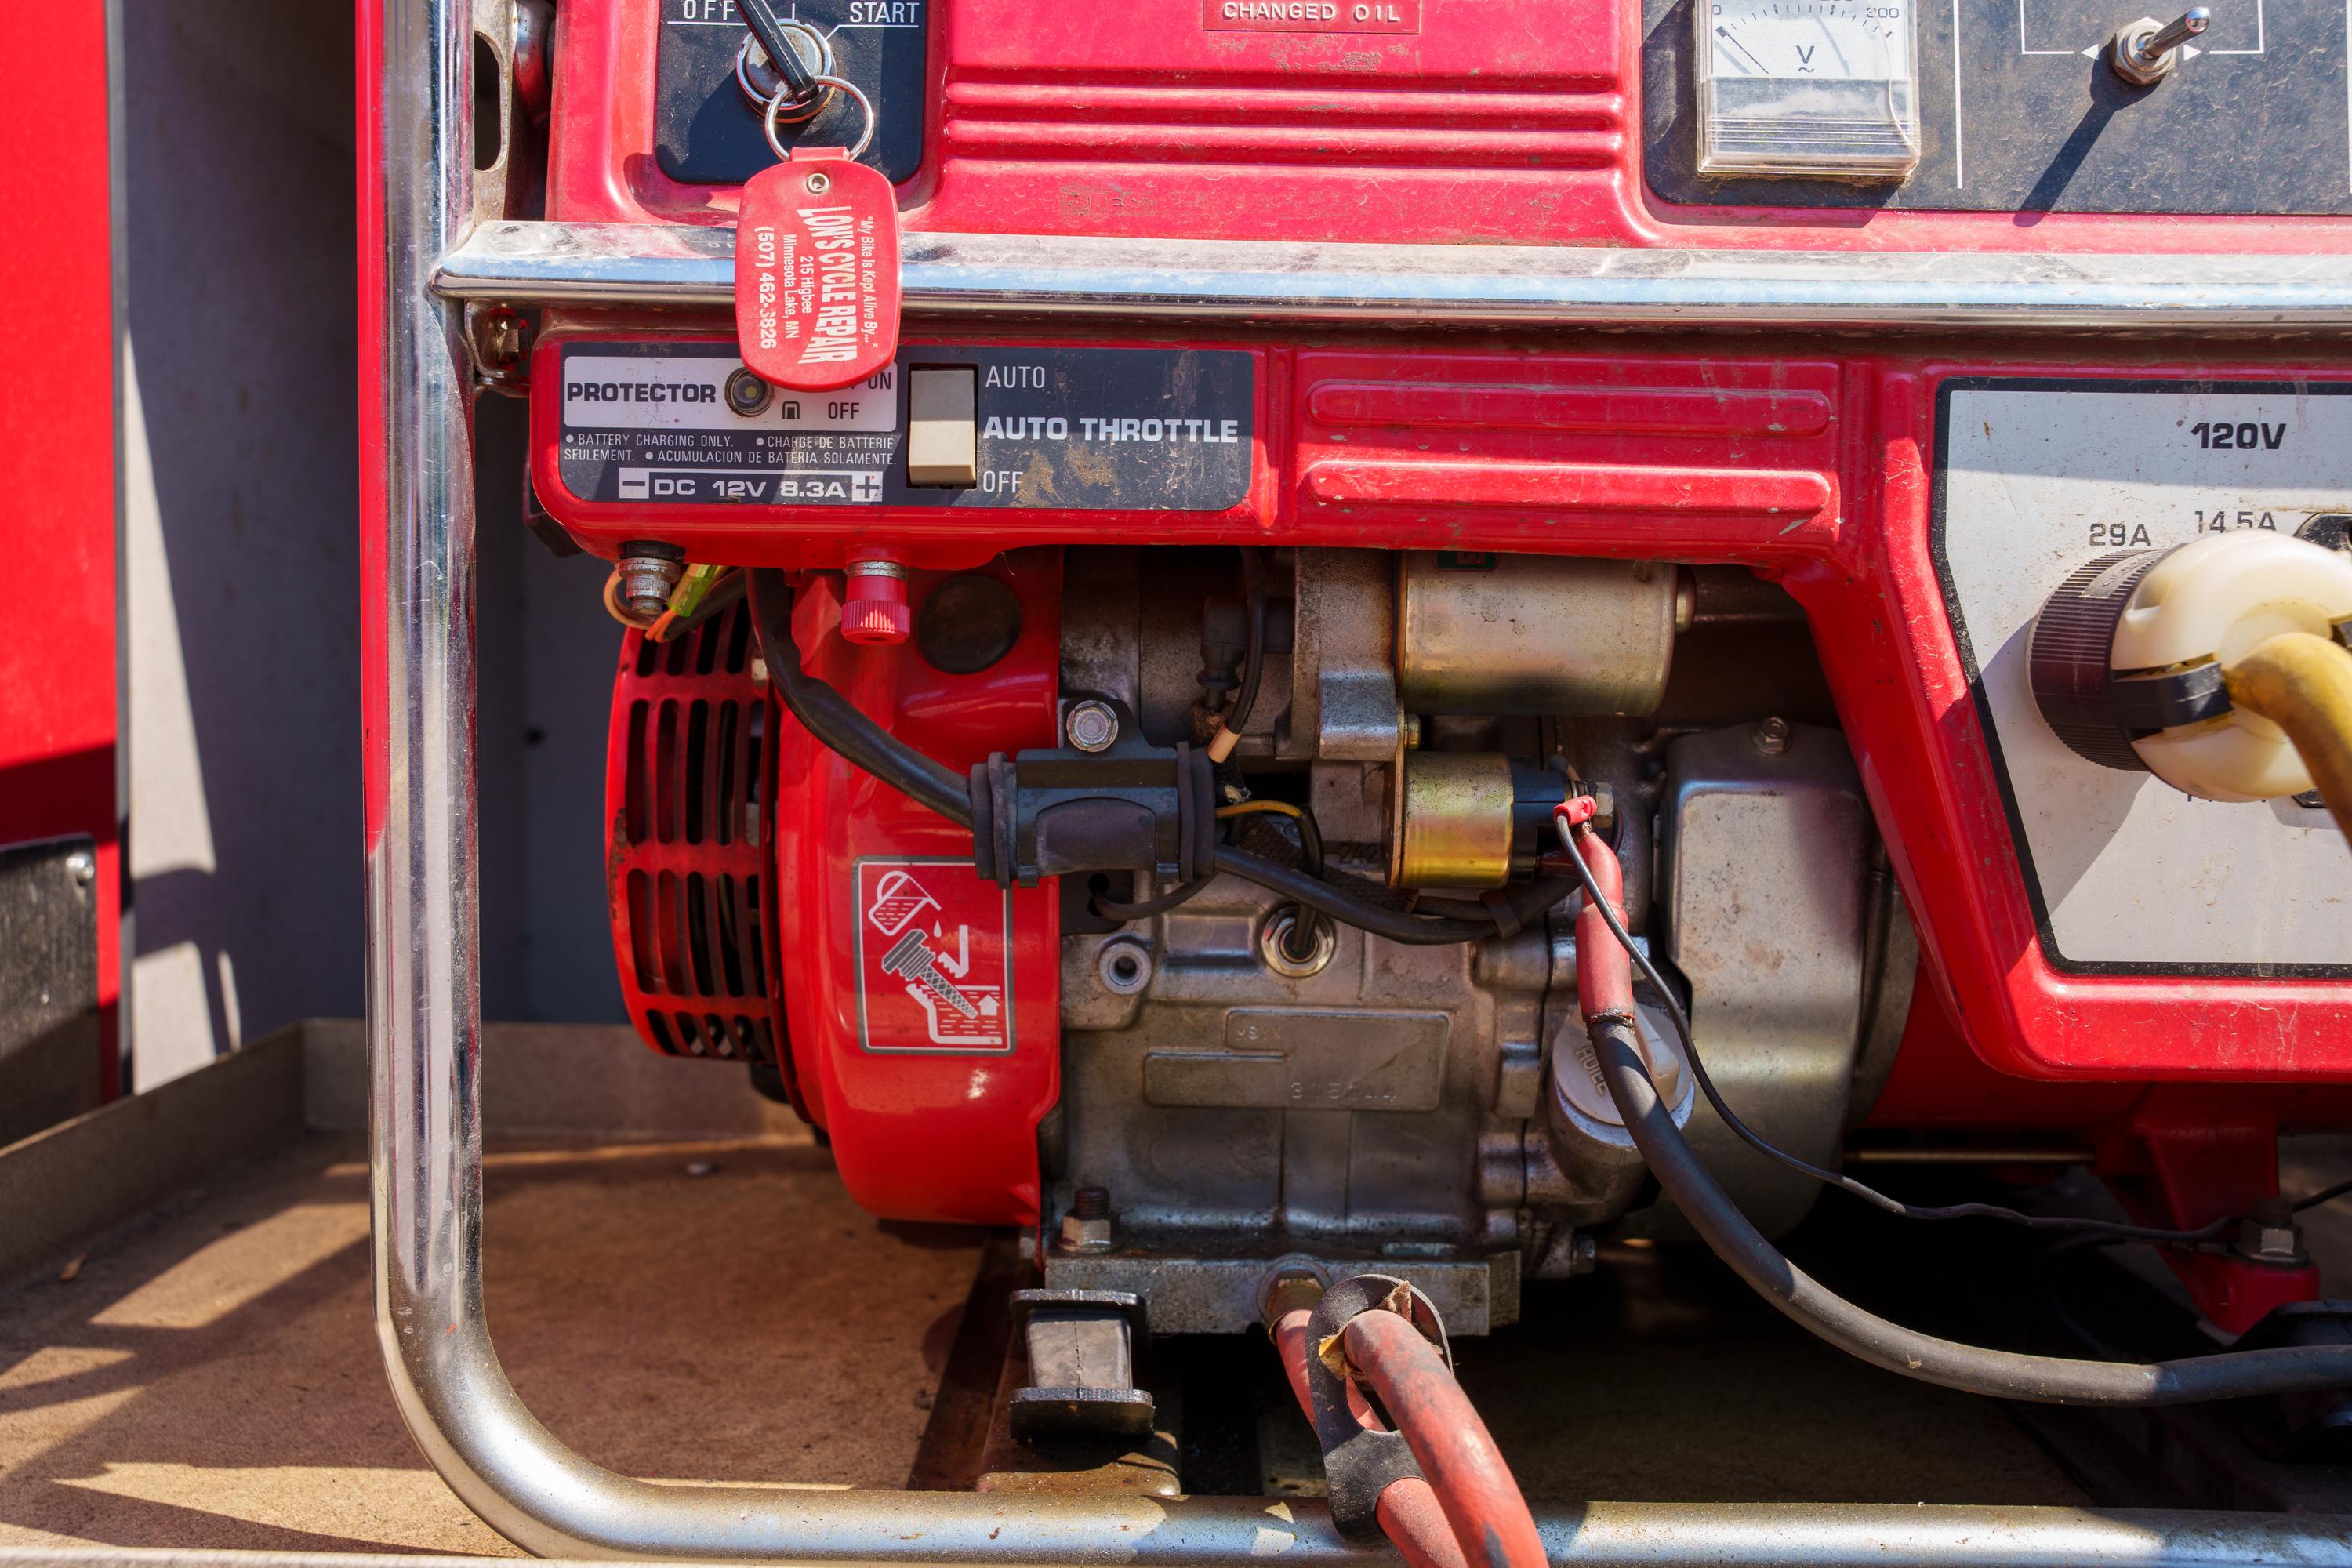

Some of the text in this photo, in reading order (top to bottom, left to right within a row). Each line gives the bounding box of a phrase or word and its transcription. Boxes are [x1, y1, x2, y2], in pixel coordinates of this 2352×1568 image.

[683, 0, 735, 20] OFF
[849, 1, 920, 23] START
[1222, 2, 1401, 22] CHANGED OIL
[1866, 7, 1899, 18] 300
[1795, 45, 1815, 64] V
[861, 236, 874, 257] Bike
[862, 259, 875, 268] Is
[754, 227, 777, 349] (507) 462-3826
[782, 234, 799, 339] Minnesota Lake, MN
[796, 205, 858, 365] LON'S CYCLE REPAIR
[799, 256, 814, 314] 215 Higbee
[860, 270, 876, 292] Kept
[863, 295, 877, 318] Alive
[985, 365, 1046, 389] AUTO
[567, 383, 717, 403] PROTECTOR
[828, 402, 859, 419] OFF
[983, 416, 1239, 443] AUTO THROTTLE
[2191, 422, 2286, 450] 120V
[579, 434, 894, 449] BATTERY CHARGING ONLY. CHARGE DE BATTERIE
[564, 448, 636, 462] SEULEMENT.
[657, 451, 742, 463] ACUMULACION
[748, 452, 763, 463] DE
[823, 452, 897, 466] SOLAMENTE.
[655, 479, 847, 498] DC 12V 8.3A
[982, 470, 1023, 493] OFF
[2194, 510, 2277, 534] 145A
[2089, 523, 2152, 546] 29A
